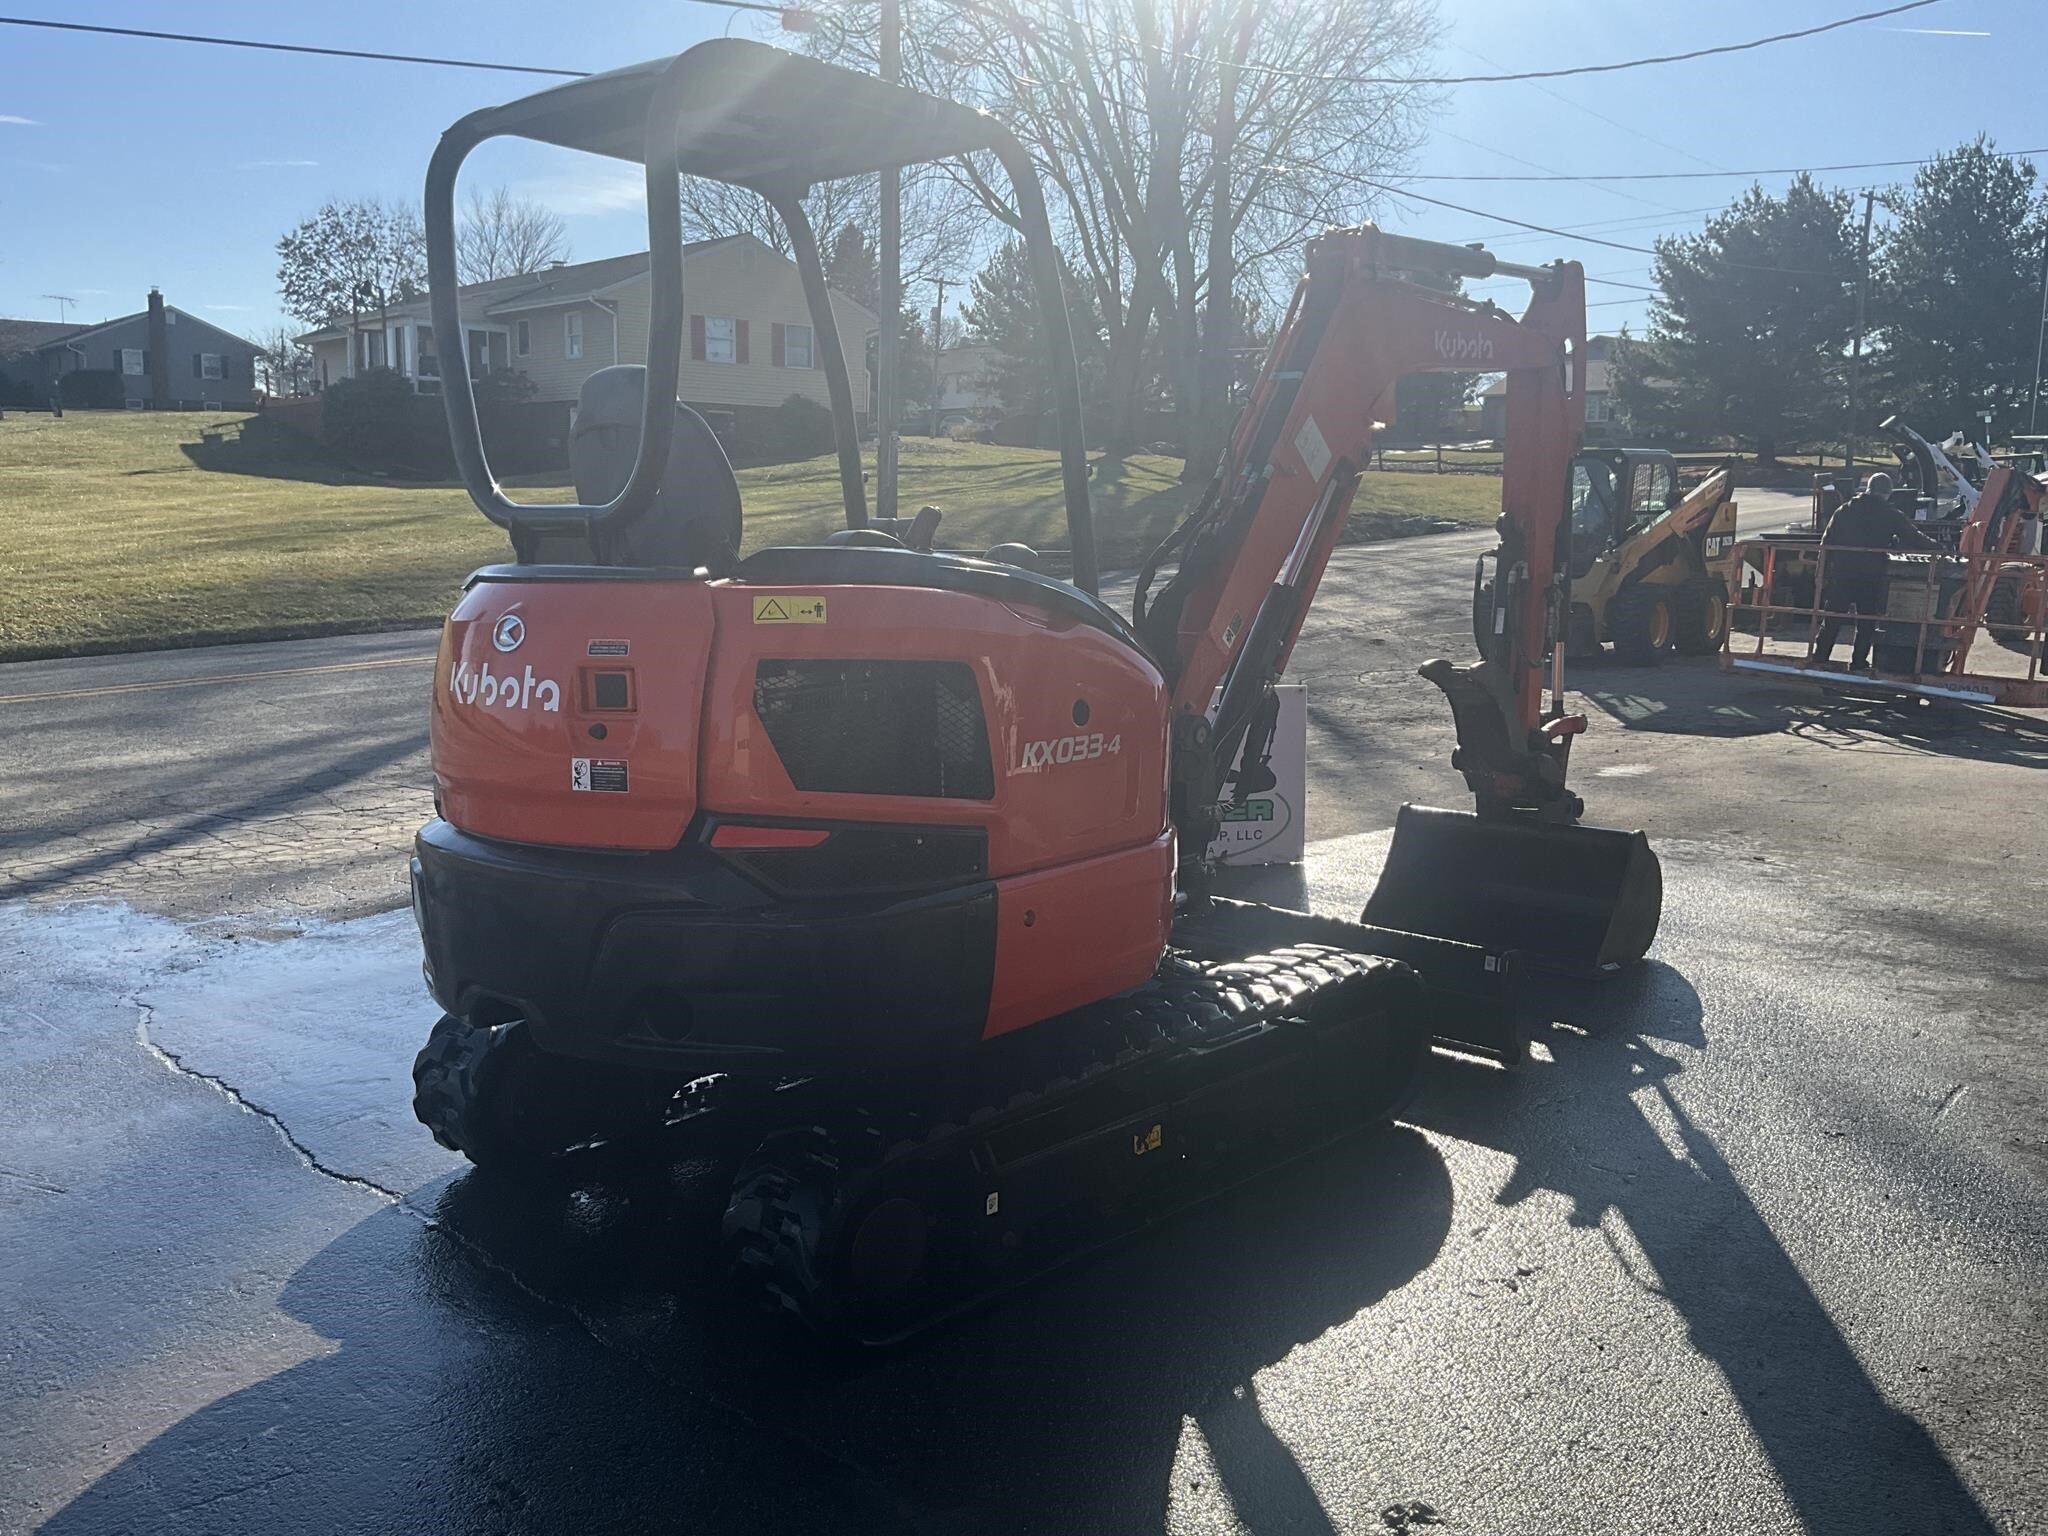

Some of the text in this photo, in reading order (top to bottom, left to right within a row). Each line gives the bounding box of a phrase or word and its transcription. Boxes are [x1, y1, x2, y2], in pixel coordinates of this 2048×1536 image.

[1434, 330, 1494, 360] Kubota
[1706, 537, 1720, 557] CAT
[449, 661, 560, 712] Kubota
[1021, 732, 1121, 769] KX033-4
[1236, 830, 1263, 841] LLC
